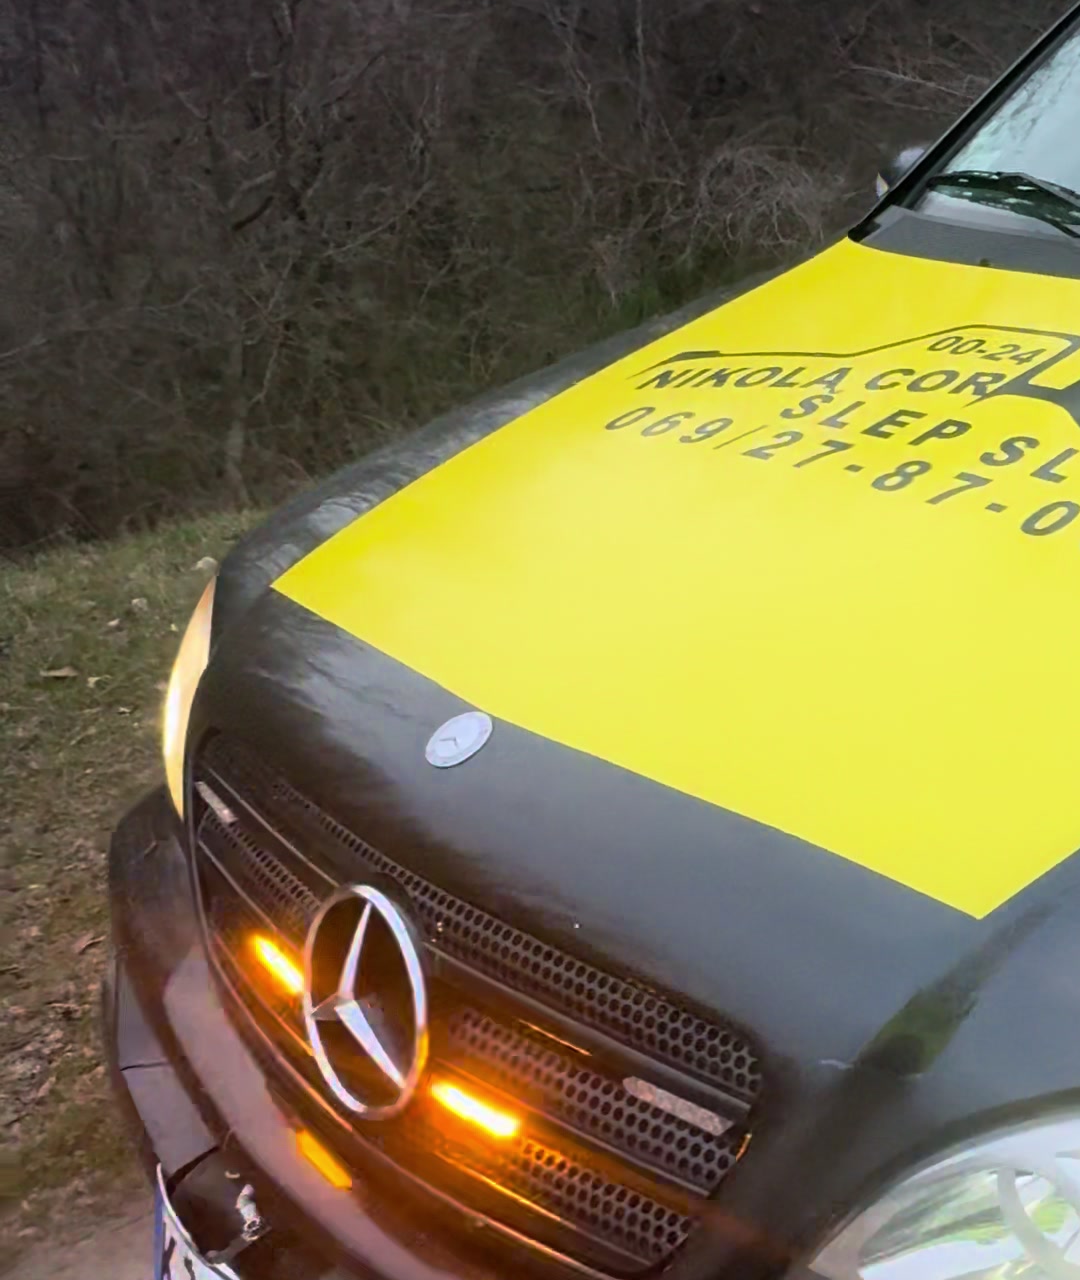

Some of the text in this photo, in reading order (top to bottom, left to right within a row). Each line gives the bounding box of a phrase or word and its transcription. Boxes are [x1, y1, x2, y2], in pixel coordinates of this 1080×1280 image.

[927, 336, 1047, 366] 00-24
[635, 366, 1007, 396] NIKOLA COR
